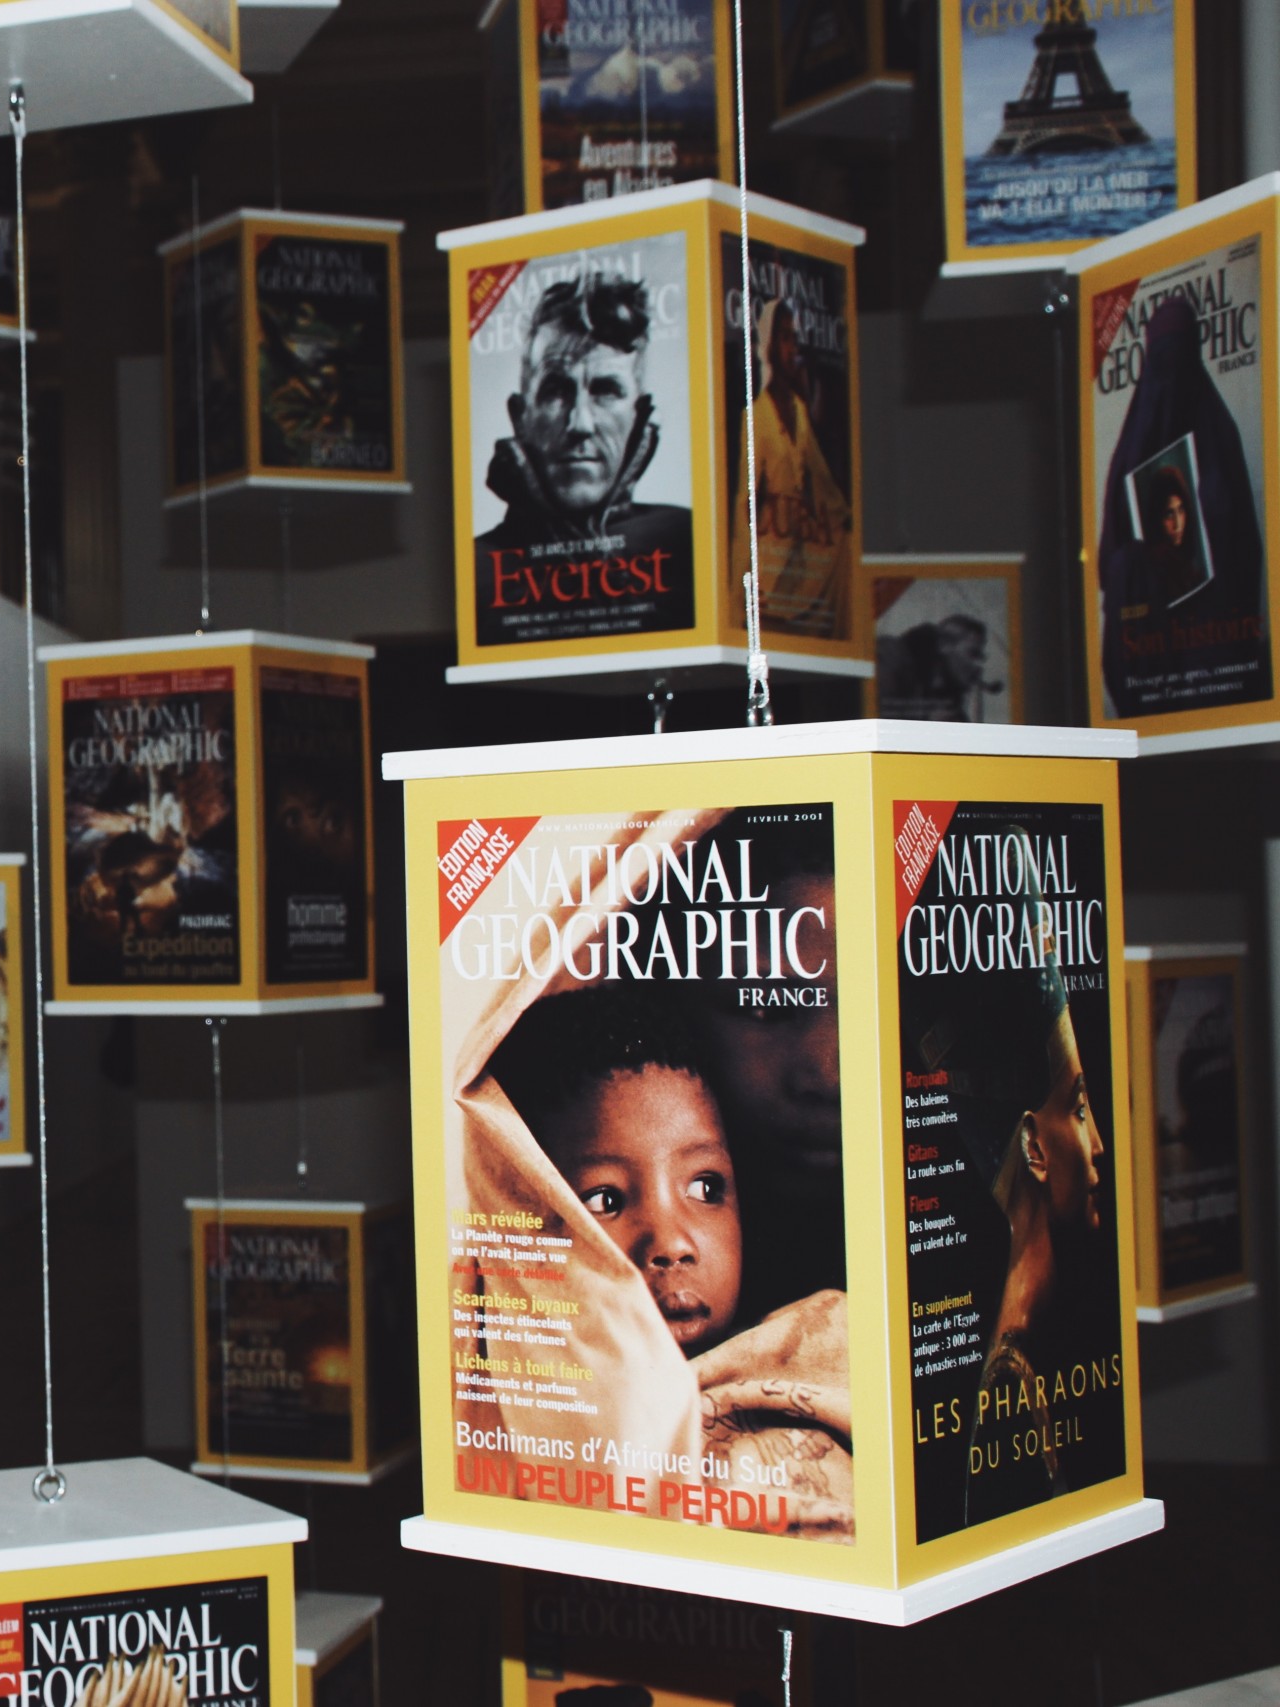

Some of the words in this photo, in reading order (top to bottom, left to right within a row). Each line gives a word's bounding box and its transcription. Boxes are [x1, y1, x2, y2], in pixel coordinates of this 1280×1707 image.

[1218, 351, 1259, 375] FRANCE
[488, 549, 673, 609] Everest
[95, 703, 204, 736] NATIONAL
[68, 730, 230, 768] GEOGRAPHIC
[747, 814, 790, 824] FEVRIER
[794, 812, 824, 822] 2001
[895, 802, 927, 865] ÉDITION
[437, 818, 489, 881] ÉDITION
[902, 815, 942, 897] FRANÇAISE
[446, 826, 515, 911] FRANÇAISE
[504, 838, 769, 908] NATIONAL
[936, 833, 1078, 897] NATIONAL
[451, 906, 828, 981] GEOGRAPHIC
[904, 899, 1104, 977] GEOGRAPHIC
[1062, 971, 1106, 994] FRANCE
[738, 987, 828, 1007] FRANCE
[906, 1069, 948, 1090] Rorquals
[905, 1095, 919, 1109] Des
[921, 1092, 950, 1107] baleines
[905, 1113, 921, 1129] très
[921, 1109, 959, 1127] convoitées
[907, 1144, 939, 1163] Gitans
[907, 1166, 917, 1180] La
[918, 1162, 937, 1178] route
[938, 1163, 954, 1175] sans
[955, 1158, 965, 1172] fin
[909, 1195, 940, 1213] Fleurs
[491, 1210, 544, 1230] révélée
[909, 1220, 923, 1234] Des
[924, 1214, 956, 1231] bouquets
[451, 1229, 463, 1241] La
[466, 1229, 503, 1244] Planète
[505, 1233, 533, 1247] rouge
[536, 1236, 573, 1248] comme
[910, 1238, 922, 1256] qui
[923, 1234, 945, 1250] valent
[945, 1233, 955, 1246] de
[956, 1230, 968, 1245] l'or
[452, 1247, 464, 1257] on
[467, 1248, 479, 1258] ne
[481, 1245, 512, 1260] l'avait
[513, 1248, 547, 1262] jamais
[549, 1253, 567, 1264] vue
[453, 1288, 528, 1310] Scarabées
[531, 1295, 579, 1315] joyaux
[912, 1301, 924, 1318] En
[925, 1290, 973, 1315] supplément
[454, 1309, 472, 1322] Des
[474, 1311, 515, 1325] insectes
[517, 1315, 573, 1331] étincelants
[912, 1323, 922, 1337] La
[923, 1319, 941, 1336] carte
[942, 1316, 952, 1326] de
[454, 1325, 470, 1338] qui
[472, 1328, 502, 1341] valent
[504, 1330, 521, 1343] des
[524, 1331, 567, 1347] fortunes
[913, 1340, 940, 1358] antique
[946, 1335, 952, 1350] 3
[952, 1332, 967, 1347] 000
[967, 1331, 980, 1343] ans
[455, 1352, 509, 1373] Lichens
[513, 1357, 522, 1374] à
[525, 1359, 556, 1378] tout
[560, 1361, 594, 1382] faire
[914, 1364, 924, 1378] de
[925, 1355, 957, 1375] dynasties
[958, 1349, 983, 1367] royales
[455, 1371, 520, 1389] Médicaments
[523, 1380, 533, 1392] et
[536, 1381, 578, 1396] parfums
[456, 1390, 497, 1404] naissent
[499, 1393, 511, 1405] de
[514, 1394, 533, 1407] leur
[536, 1399, 599, 1415] composition
[915, 1398, 962, 1445] LES
[977, 1353, 1122, 1426] PHARAONS
[456, 1421, 575, 1461] Bochimans
[581, 1437, 692, 1478] d'Afrique
[700, 1450, 730, 1480] du
[739, 1454, 788, 1488] Sud
[970, 1440, 1000, 1475] DU
[1012, 1416, 1084, 1462] SOLEIL
[457, 1453, 509, 1496] UN
[515, 1461, 648, 1514] PEUPLE
[658, 1480, 790, 1534] PERDU
[30, 1603, 221, 1667] NATIONAL
